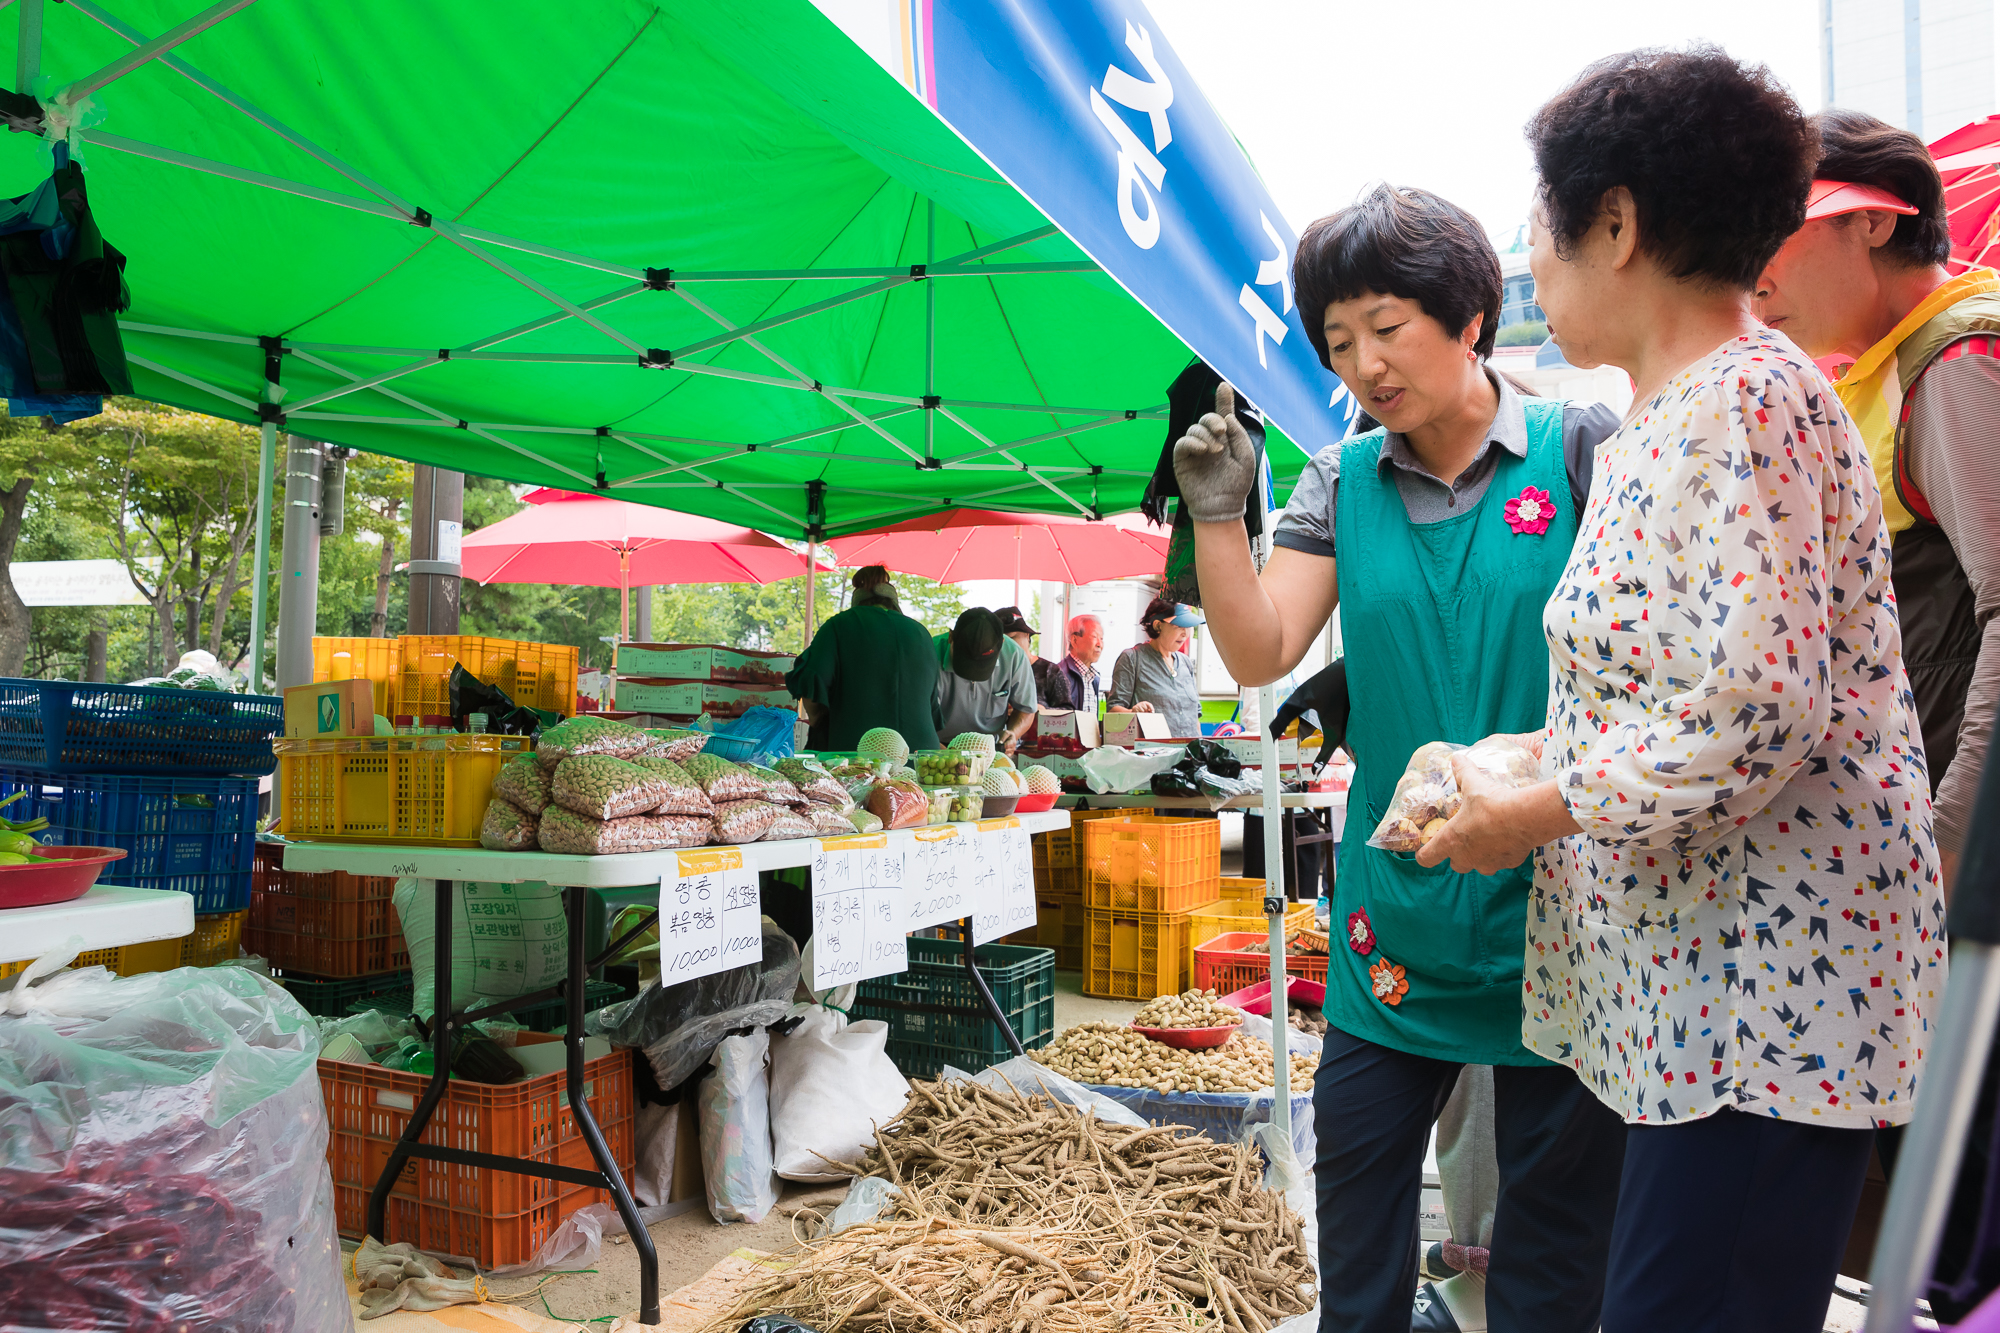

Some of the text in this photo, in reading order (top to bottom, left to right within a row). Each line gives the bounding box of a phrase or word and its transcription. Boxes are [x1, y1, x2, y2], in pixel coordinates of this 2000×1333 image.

[674, 875, 712, 905] 땅콩
[470, 902, 517, 916] 포장일자
[474, 923, 521, 937] 보관방법
